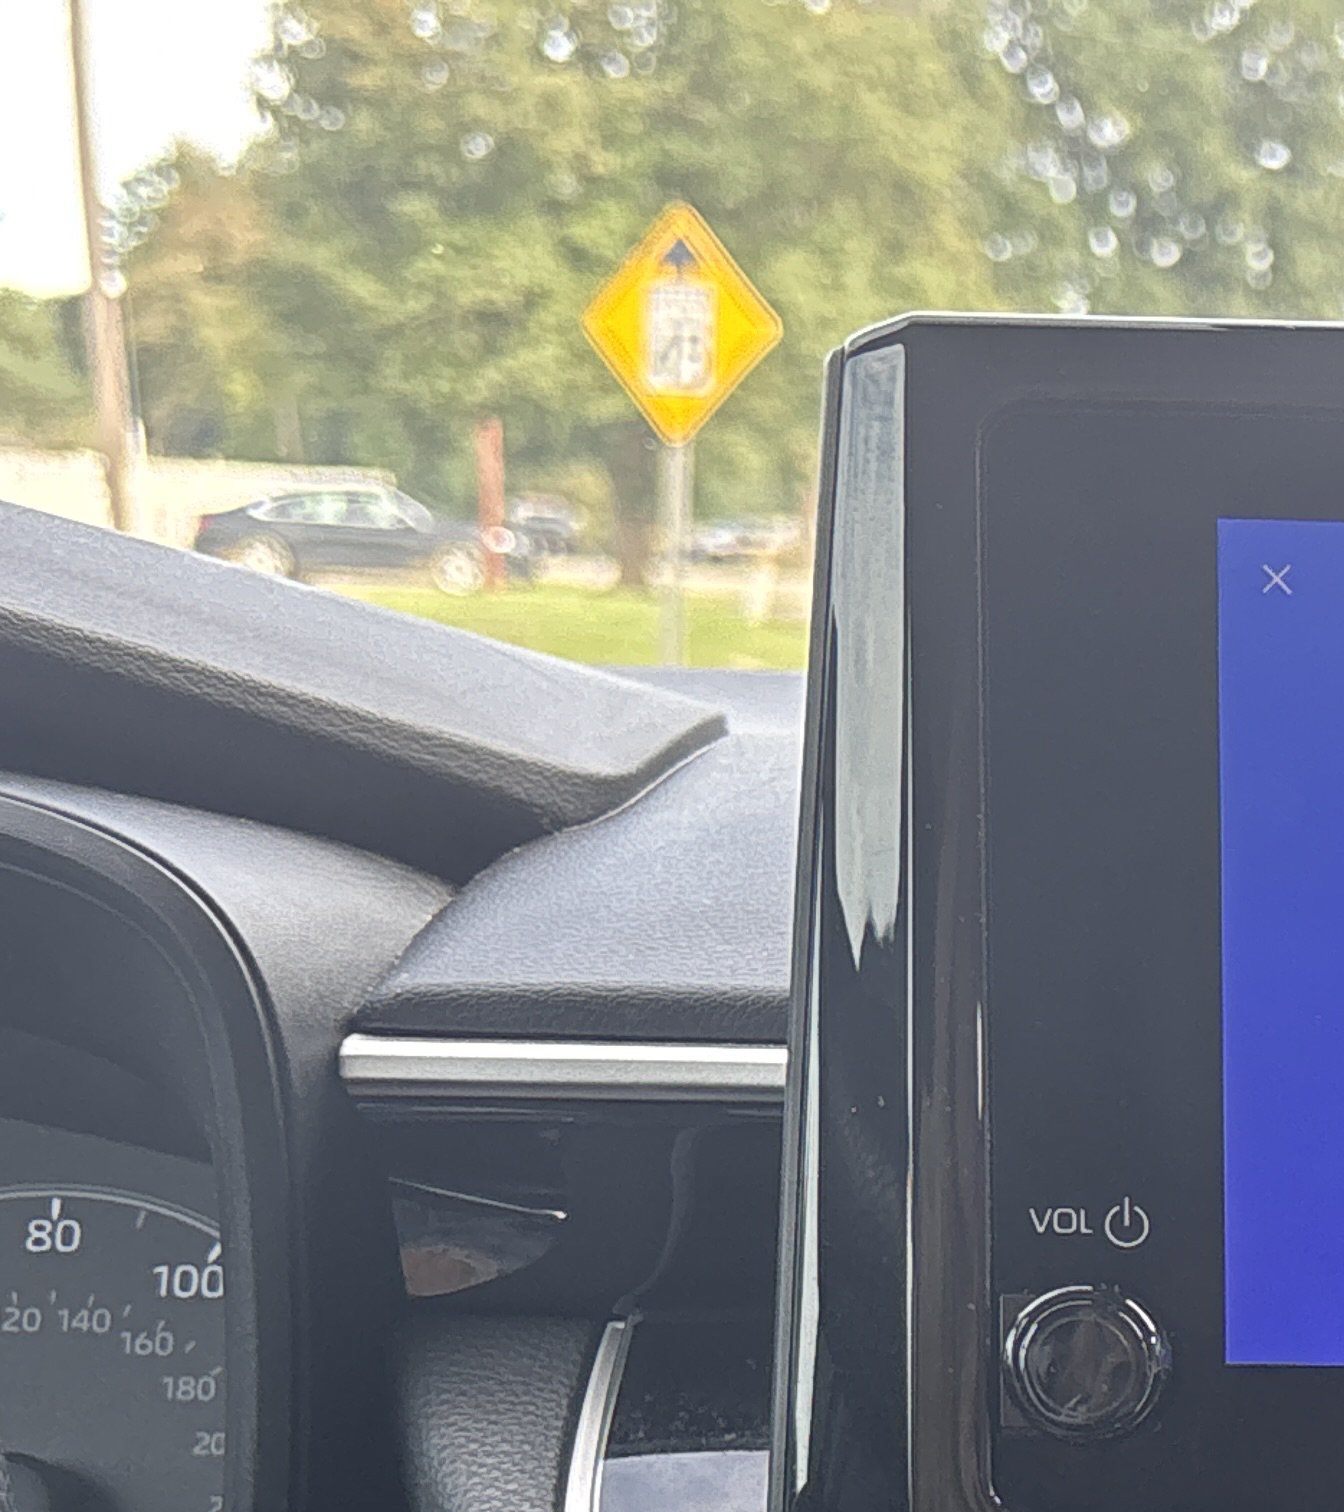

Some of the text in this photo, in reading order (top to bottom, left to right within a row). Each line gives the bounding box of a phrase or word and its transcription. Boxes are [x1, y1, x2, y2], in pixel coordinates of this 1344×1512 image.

[1029, 1207, 1094, 1234] VOL
[25, 1218, 82, 1253] 80
[152, 1264, 224, 1298] 100
[0, 1307, 42, 1333] 20
[57, 1307, 112, 1333] 140
[120, 1330, 174, 1356] 160
[162, 1375, 216, 1401] 180
[192, 1432, 225, 1456] 20
